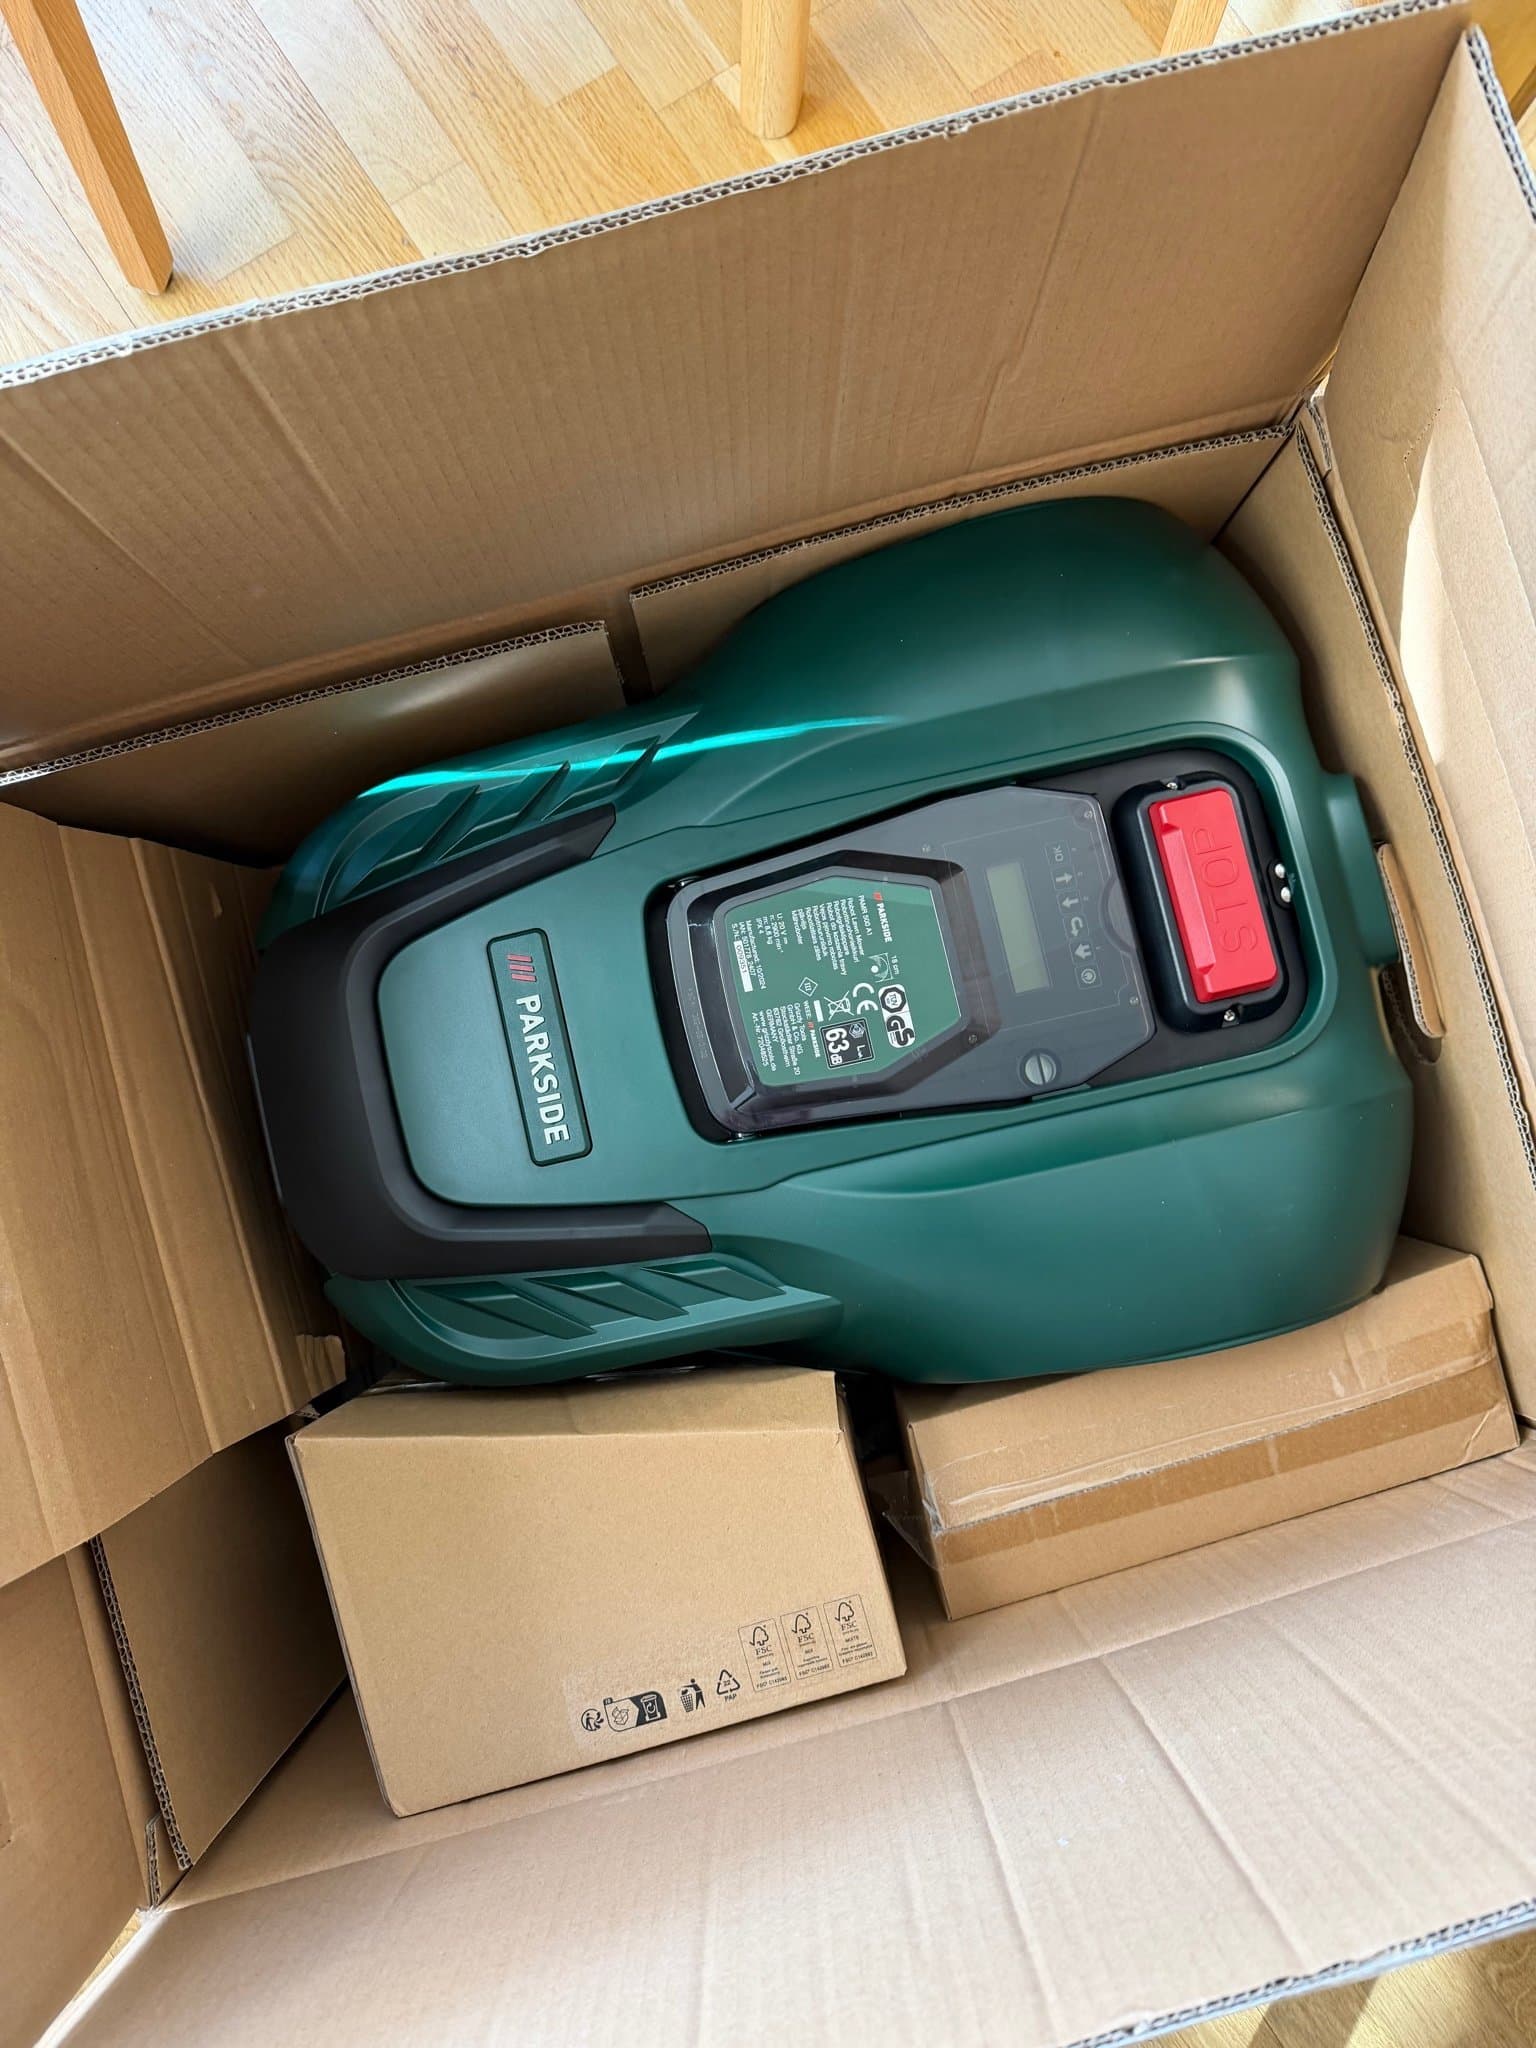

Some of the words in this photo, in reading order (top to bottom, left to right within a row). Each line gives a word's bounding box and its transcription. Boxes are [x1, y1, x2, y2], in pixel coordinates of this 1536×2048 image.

[1053, 845, 1065, 862] OK
[1191, 826, 1257, 953] STOP
[826, 901, 835, 920] Robot
[847, 897, 856, 916] Robot
[858, 894, 867, 913] PAMR
[755, 917, 763, 929] IPX
[778, 920, 785, 929] 20
[830, 921, 837, 930] do
[851, 916, 860, 934] Lawn
[862, 914, 870, 926] 500
[876, 902, 892, 943] PARKSIDE
[765, 936, 773, 944] kg
[865, 927, 872, 935] A1
[855, 934, 865, 955] Mower
[755, 964, 766, 989] 10/2024
[892, 964, 899, 974] cm
[786, 1004, 796, 1024] GmbH
[765, 1008, 778, 1043] GERMANY
[798, 1023, 808, 1041] Tools
[809, 1029, 820, 1057] PARKSIDE
[825, 1027, 850, 1053] 63
[830, 1054, 843, 1065] dB
[516, 995, 570, 1145] PARKSIDE
[793, 1066, 800, 1075] 20
[841, 1621, 856, 1631] FSC
[798, 1633, 815, 1643] FSC
[755, 1645, 772, 1655] FSC
